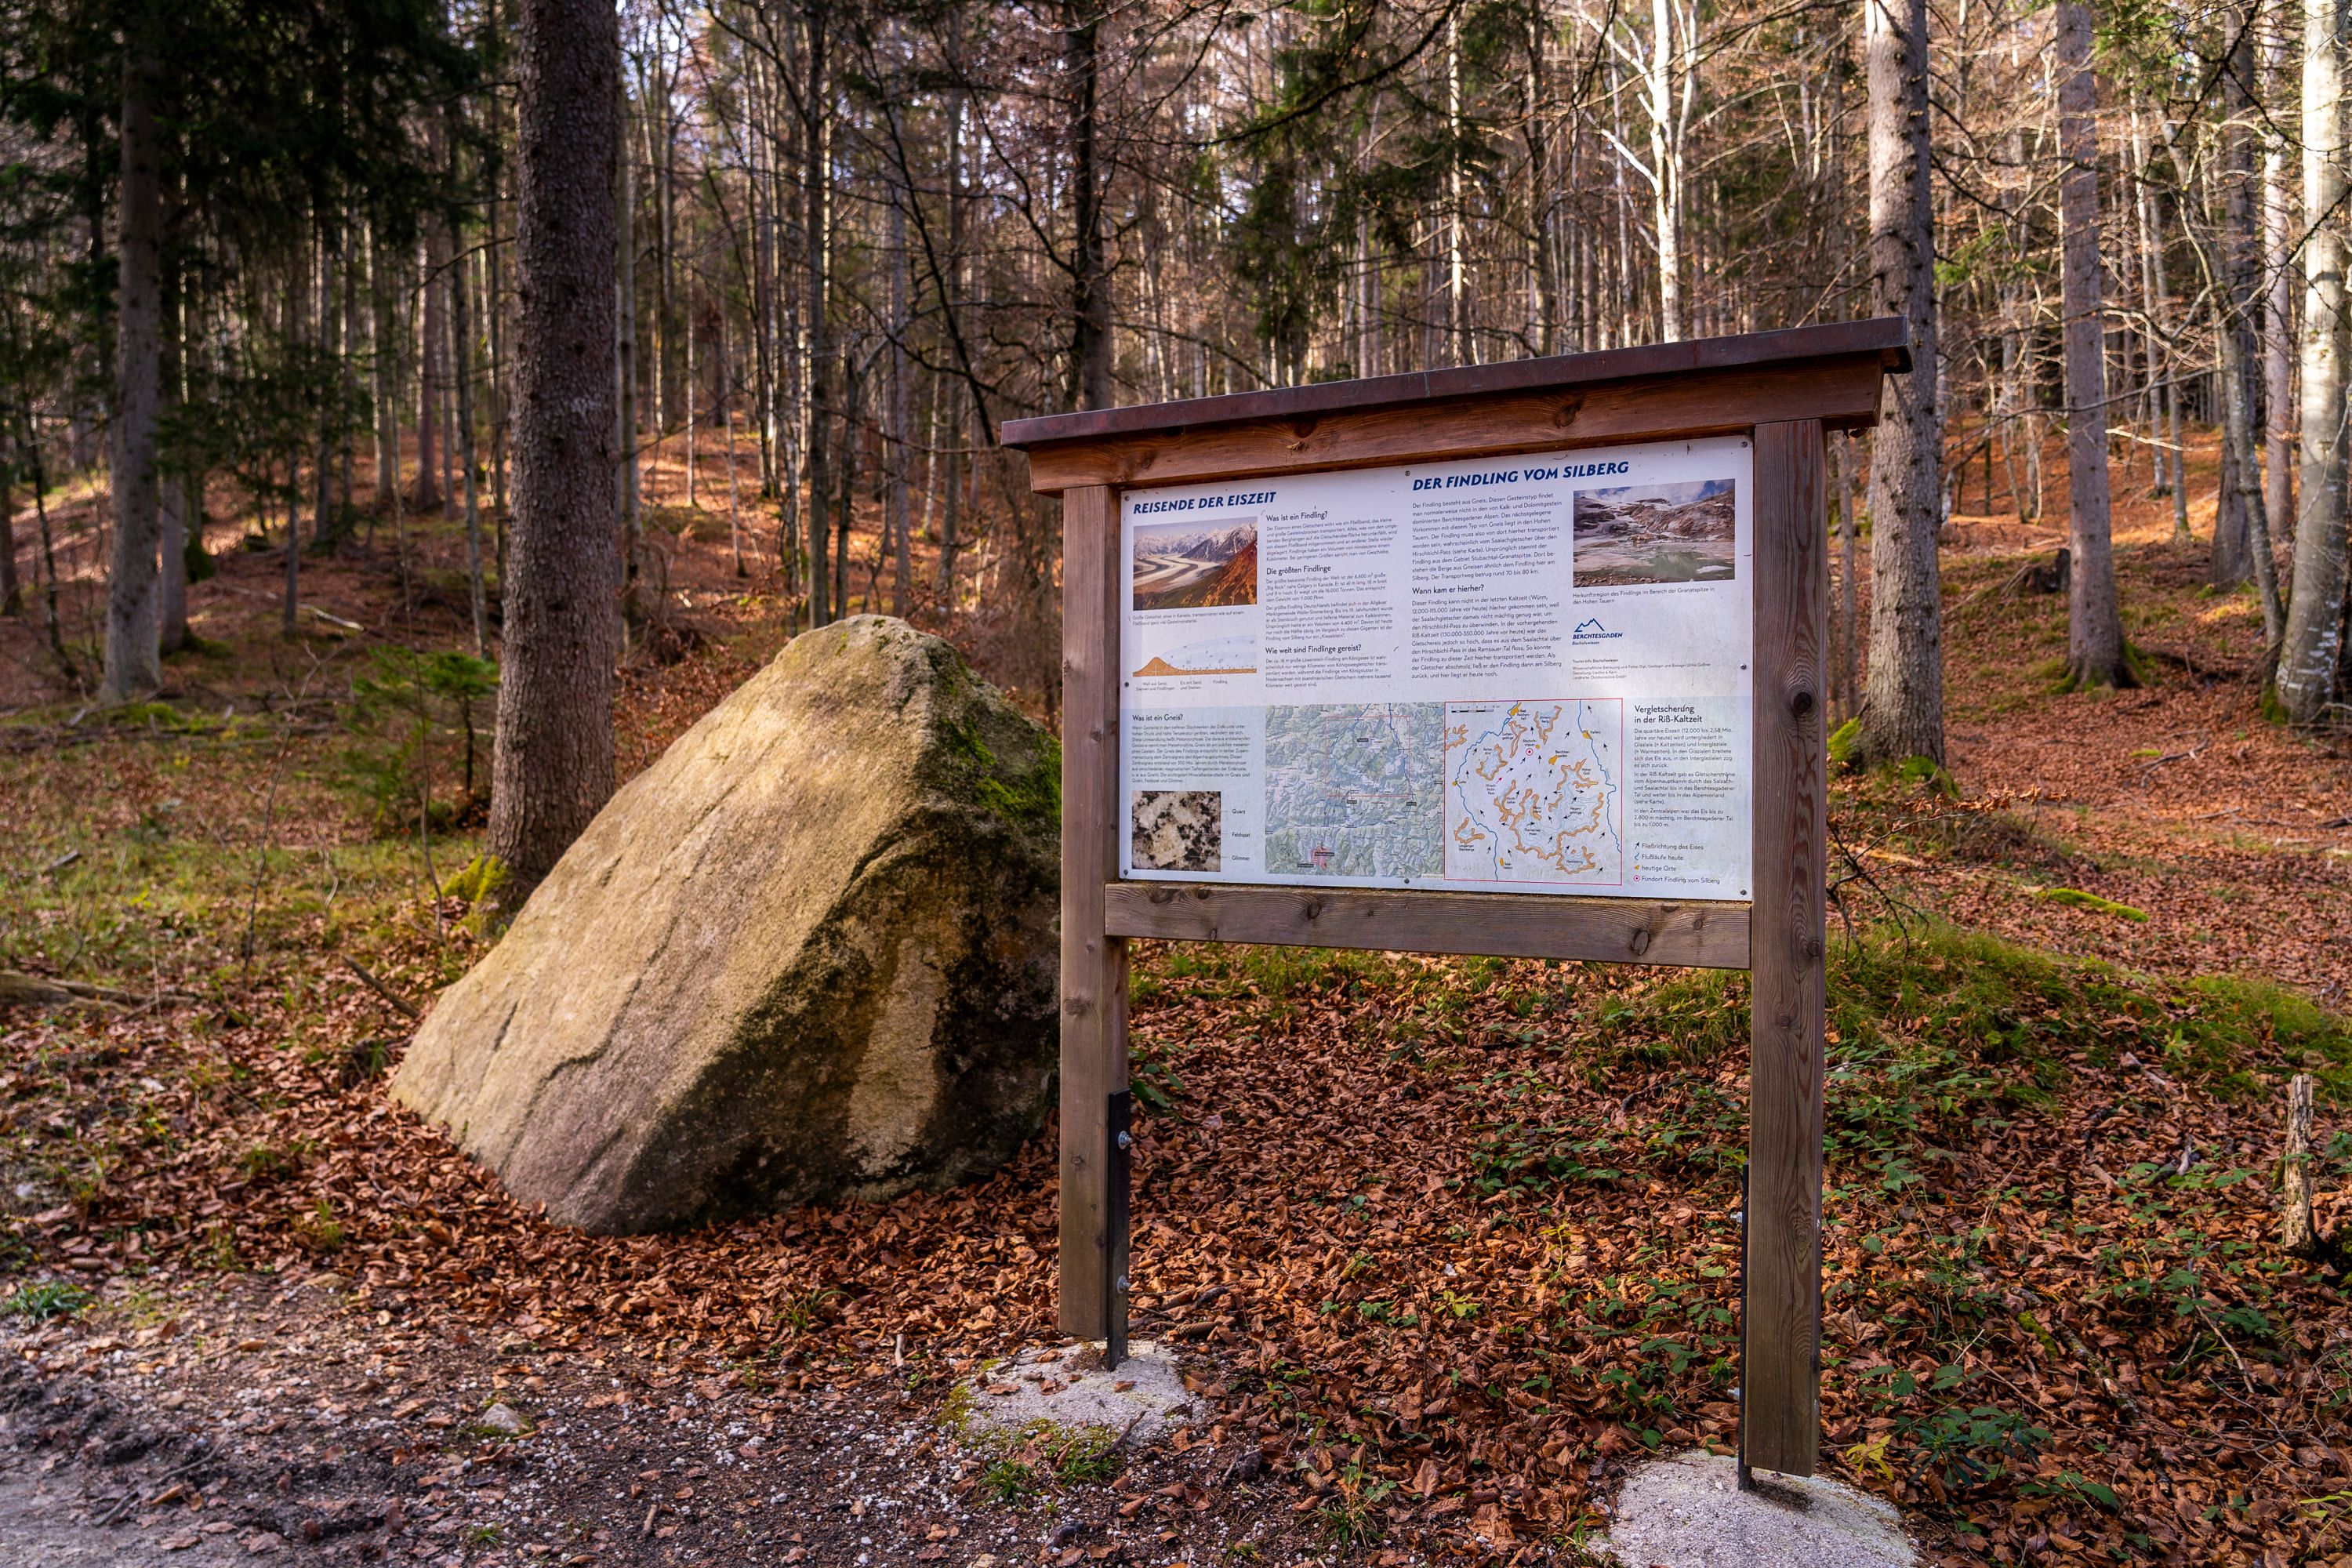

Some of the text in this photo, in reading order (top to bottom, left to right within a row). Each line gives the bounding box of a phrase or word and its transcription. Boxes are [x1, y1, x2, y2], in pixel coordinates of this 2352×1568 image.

[1413, 462, 1628, 491] DER FINDLING VOM SILBERG
[1134, 492, 1276, 514] REISENDE DER EISZEIT
[1506, 493, 1537, 503] Gesteinstyp
[1424, 507, 1458, 516] normalerweise
[1523, 499, 1562, 510] Dolomitgestein
[1266, 514, 1279, 522] Was
[1290, 512, 1299, 521] ein
[1301, 510, 1328, 521] Findling?
[1442, 514, 1483, 524] Berchtesgadener
[1512, 509, 1552, 518] nächstgelegene
[1278, 565, 1301, 576] größten
[1303, 564, 1331, 575] Findlinge
[1441, 572, 1474, 580] Transportweg
[1457, 584, 1484, 593] hierher?
[1308, 644, 1336, 655] Findlinge
[1338, 644, 1361, 653] gereist?
[1635, 704, 1694, 715] Vergletscherung
[1635, 714, 1702, 724] in der Riß-Kaltzeit
[1664, 876, 1686, 884] Findling
